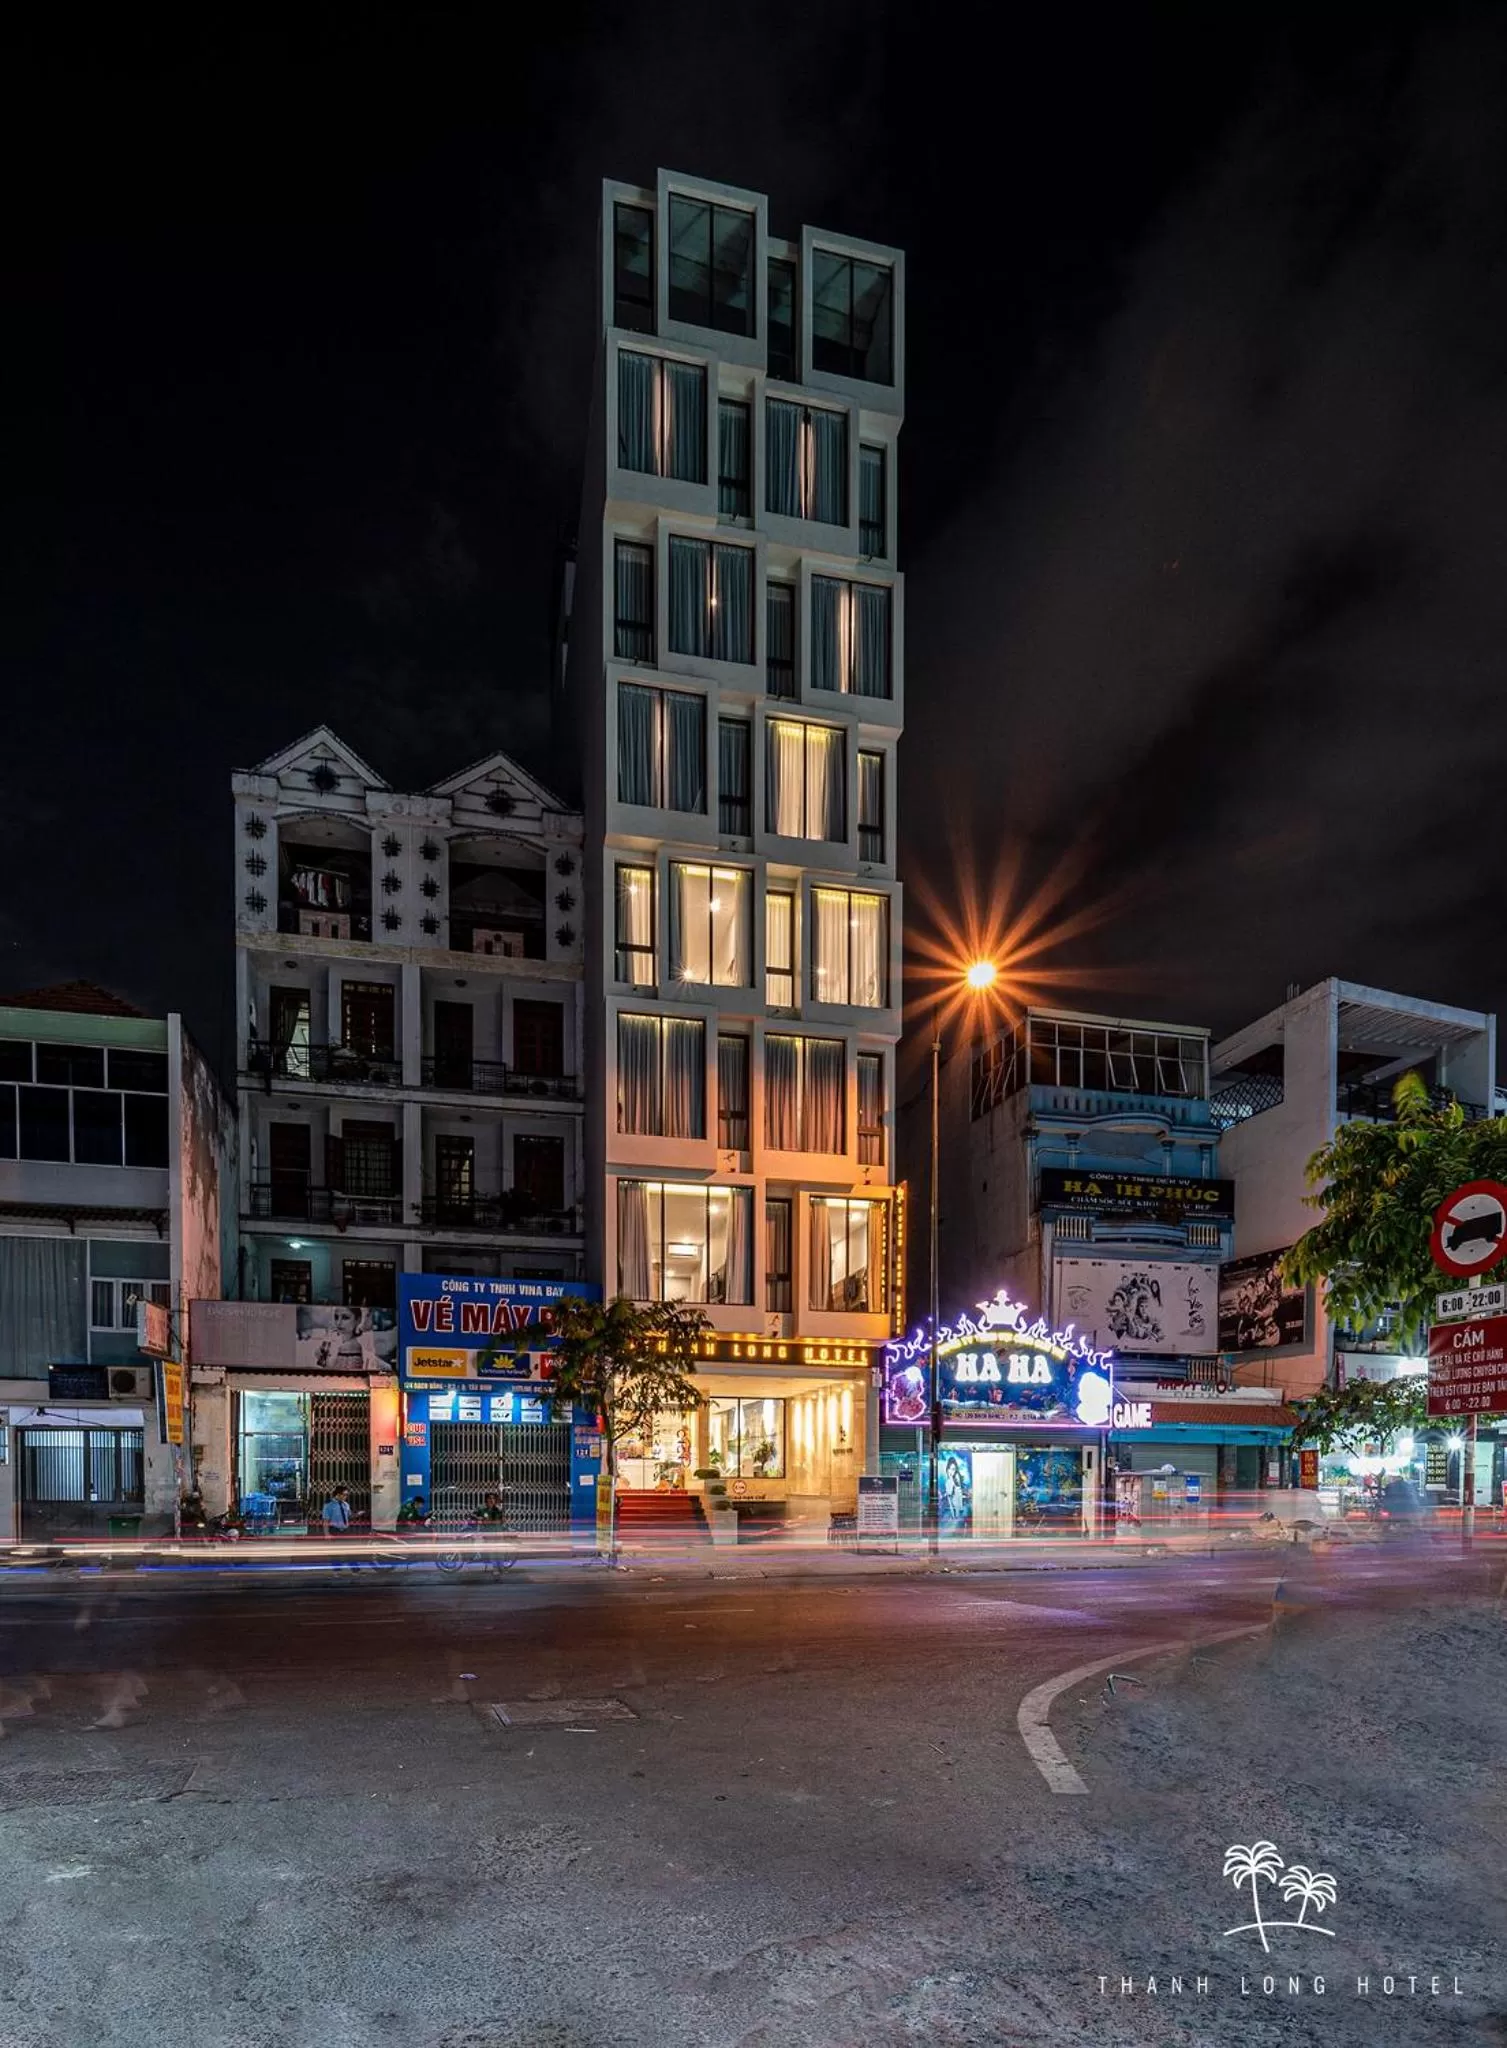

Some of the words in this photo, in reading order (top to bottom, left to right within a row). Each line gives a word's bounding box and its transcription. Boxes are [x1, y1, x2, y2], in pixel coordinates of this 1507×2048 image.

[442, 1280, 469, 1292] CÔNG
[474, 1282, 485, 1293] TY
[490, 1283, 516, 1294] TNHH
[519, 1285, 542, 1296] VINA
[545, 1286, 564, 1297] BAY
[1442, 1297, 1463, 1312] 6:00
[1472, 1290, 1500, 1307] 22:00
[411, 1295, 454, 1333] VÉ
[461, 1298, 532, 1335] MÁY
[1453, 1325, 1485, 1348] CẤM
[413, 1357, 453, 1368] Jetstar
[734, 1344, 787, 1358] LONG
[804, 1347, 868, 1361] HOTEL
[955, 1352, 1001, 1383] HA
[1007, 1354, 1052, 1384] HA
[1113, 1403, 1152, 1429] GAME
